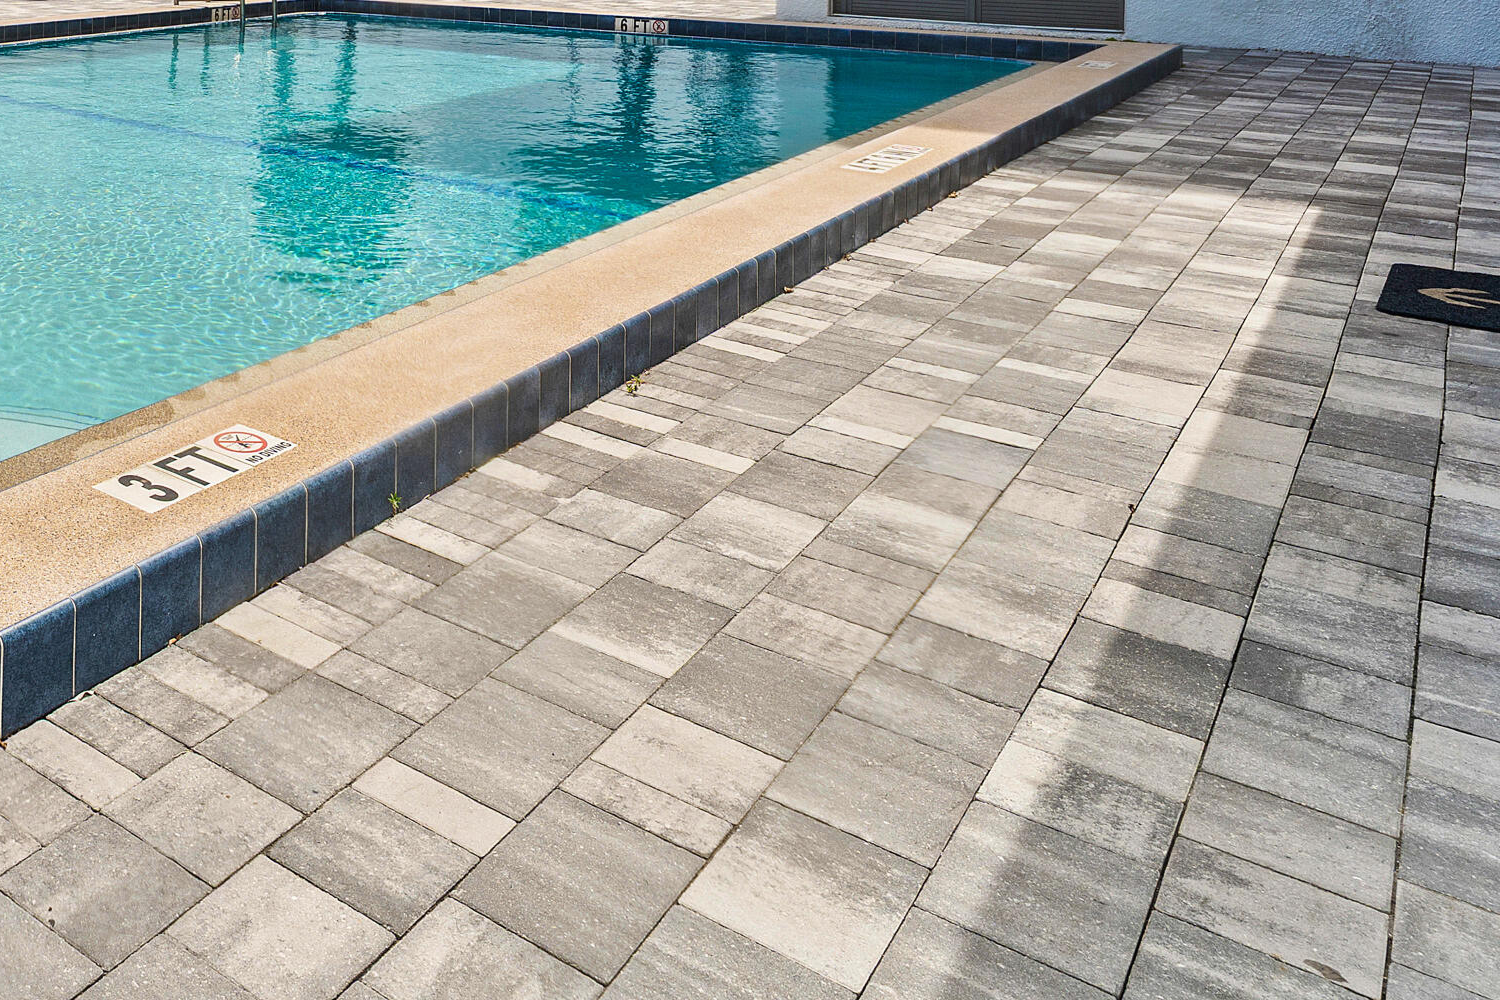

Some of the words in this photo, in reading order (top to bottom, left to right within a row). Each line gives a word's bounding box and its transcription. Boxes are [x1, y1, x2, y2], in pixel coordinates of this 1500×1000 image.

[620, 18, 628, 32] 6
[633, 19, 649, 33] FT
[245, 455, 264, 464] NO
[258, 441, 292, 458] DIVING
[117, 474, 179, 502] 3
[152, 445, 240, 487] FT
